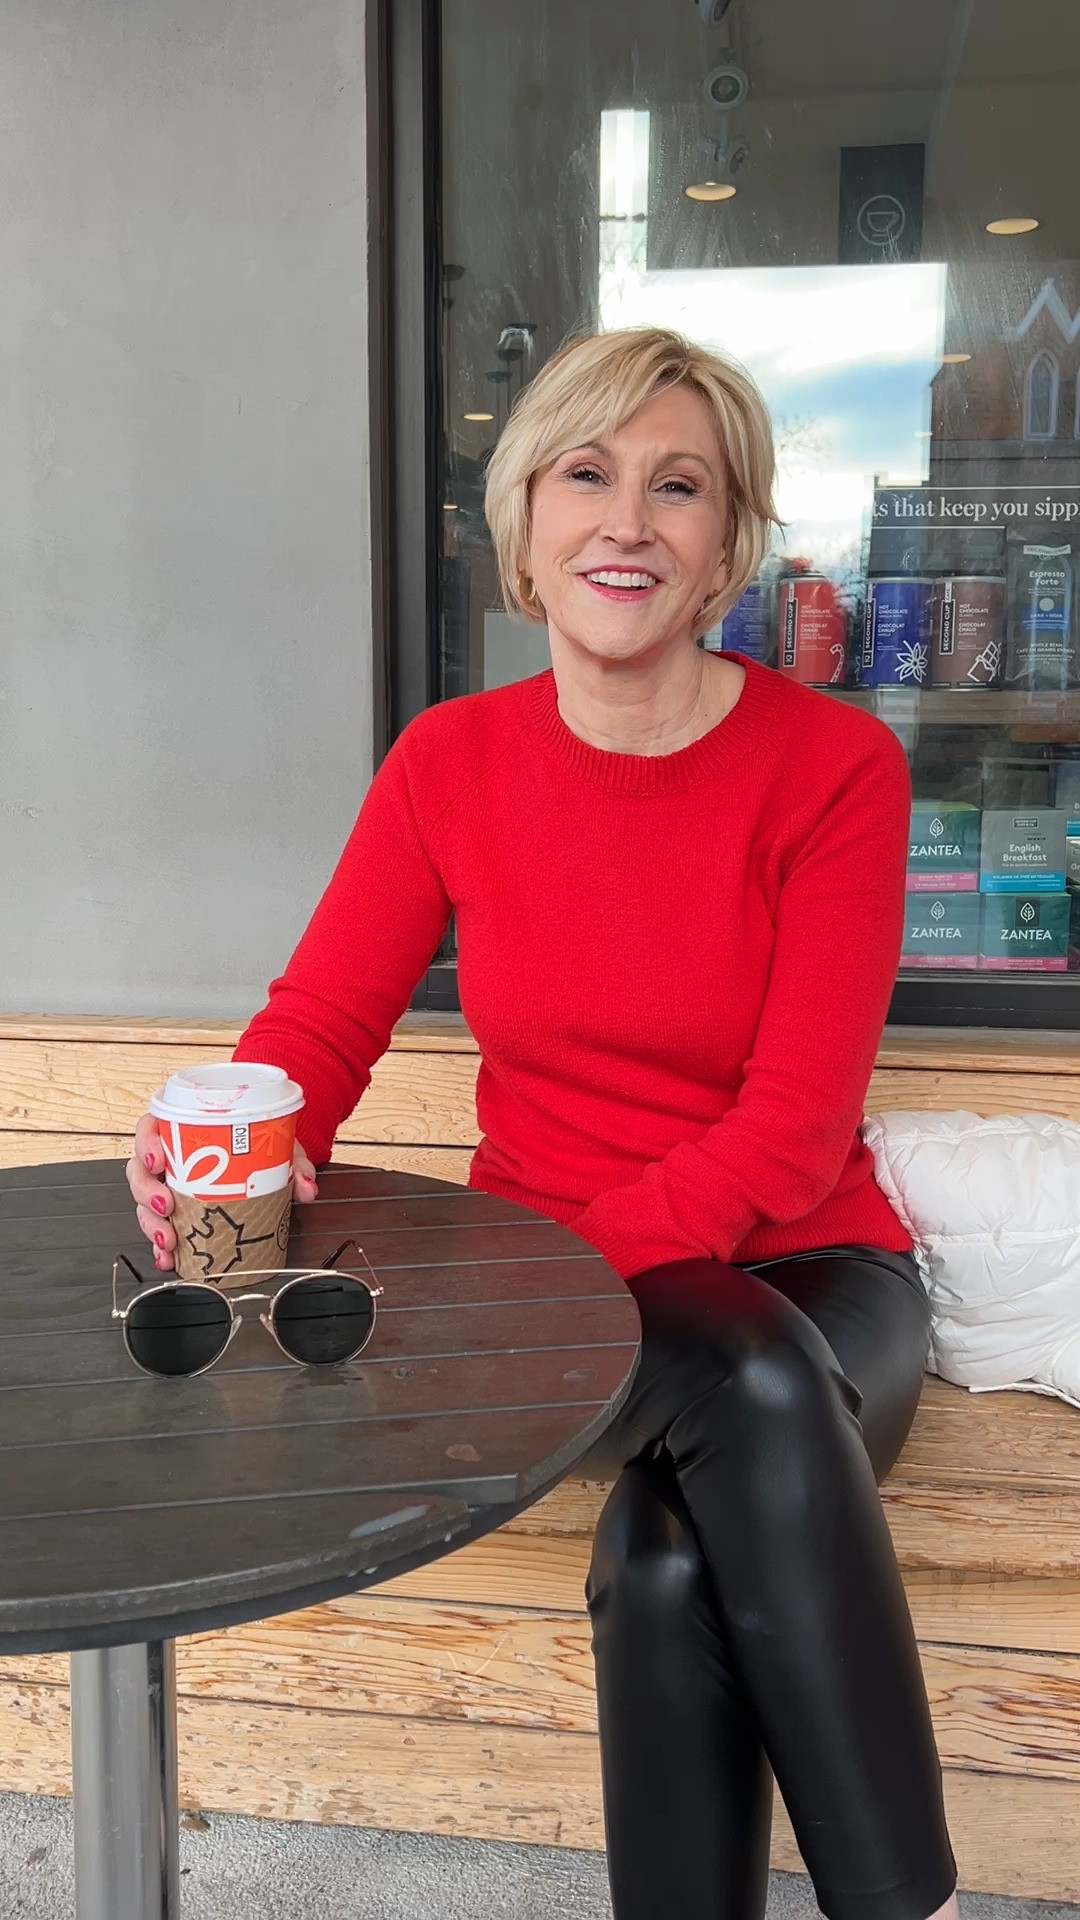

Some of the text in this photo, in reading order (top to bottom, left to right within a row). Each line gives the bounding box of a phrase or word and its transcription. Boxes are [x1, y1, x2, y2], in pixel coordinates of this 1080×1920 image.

[895, 497, 936, 517] that
[940, 497, 988, 521] keep
[991, 502, 1028, 521] you
[1035, 496, 1080, 521] sipp
[1029, 570, 1065, 578] Espresso
[910, 845, 961, 856] ZANTEA
[1009, 844, 1041, 853] English
[1003, 853, 1047, 861] Breakfast
[911, 927, 962, 938] ZANTEA
[1000, 929, 1052, 940] ZANTEA
